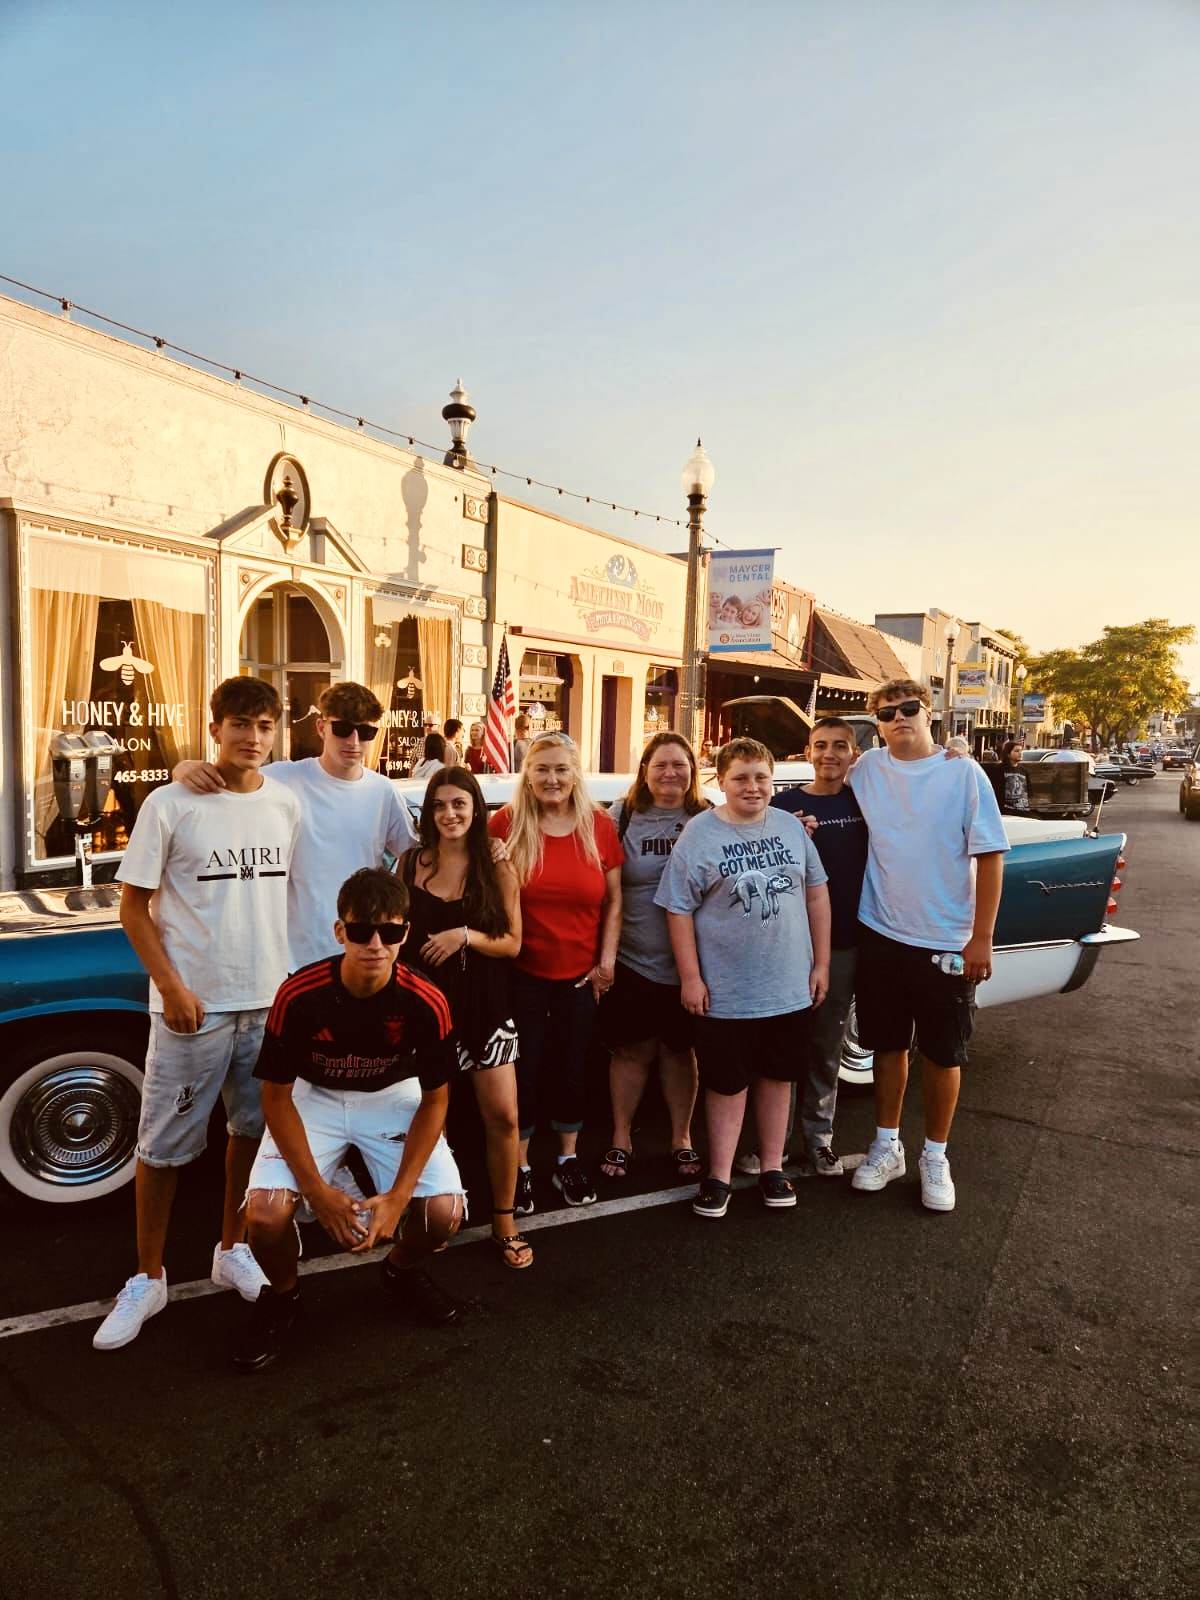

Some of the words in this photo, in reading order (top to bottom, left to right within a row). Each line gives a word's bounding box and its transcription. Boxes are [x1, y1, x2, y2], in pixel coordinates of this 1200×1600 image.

[729, 572, 770, 583] DENTAL
[62, 700, 125, 726] HONEY
[129, 702, 144, 727] &
[147, 702, 185, 727] HIVE
[411, 710, 420, 728] &
[114, 769, 169, 783] 465-8333
[205, 847, 281, 869] AMIRI
[721, 836, 785, 860] MONDAYS
[718, 857, 746, 879] GOT
[747, 855, 767, 871] ME
[323, 1068, 342, 1078] FLY
[345, 1065, 387, 1079] BETTER
